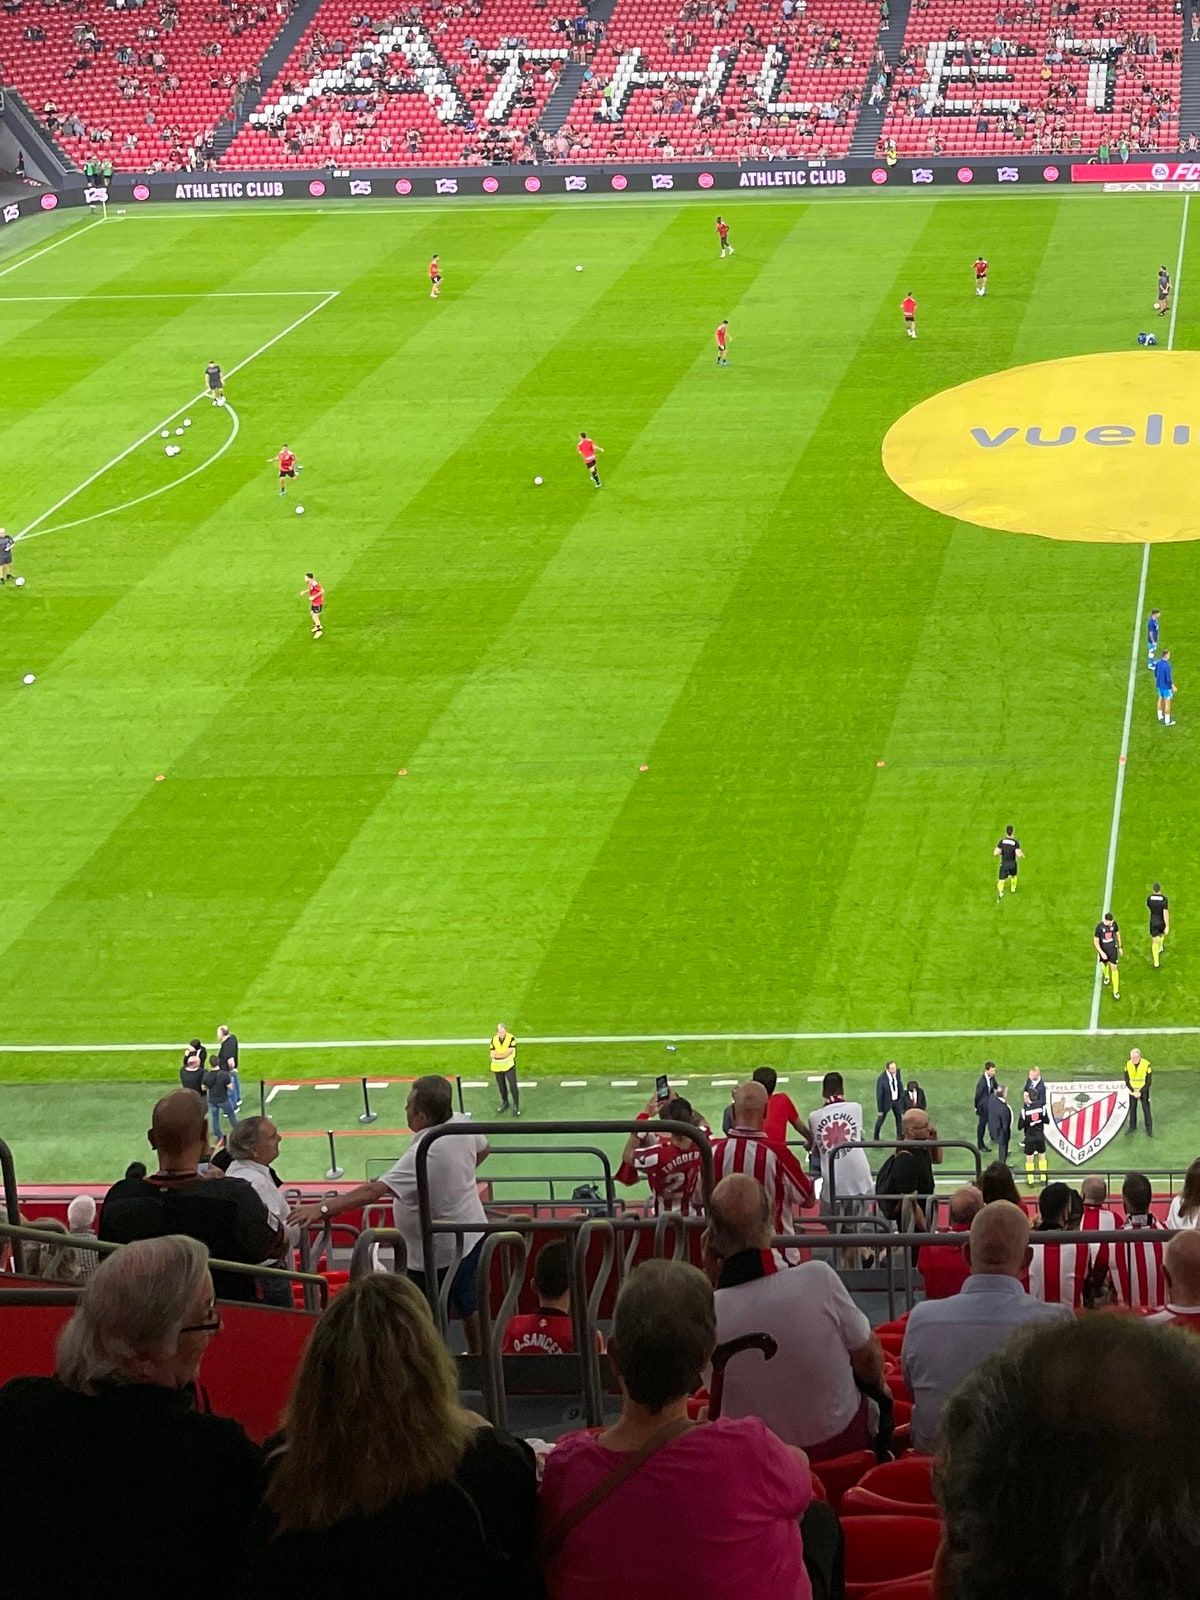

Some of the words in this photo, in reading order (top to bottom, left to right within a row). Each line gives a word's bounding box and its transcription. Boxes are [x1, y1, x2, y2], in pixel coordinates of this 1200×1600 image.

[652, 174, 674, 189] 125
[739, 171, 806, 187] ATHLETIC
[810, 170, 846, 184] CLUB
[912, 167, 934, 183] 125
[997, 166, 1019, 182] 125
[176, 183, 243, 198] ATHLETIC
[247, 182, 283, 196] CLUB
[350, 180, 372, 196] 125
[435, 178, 458, 194] 125
[565, 175, 587, 191] 125
[1104, 183, 1164, 193] SAN
[817, 1115, 831, 1133] HOT
[1059, 1138, 1102, 1161] BILBAO
